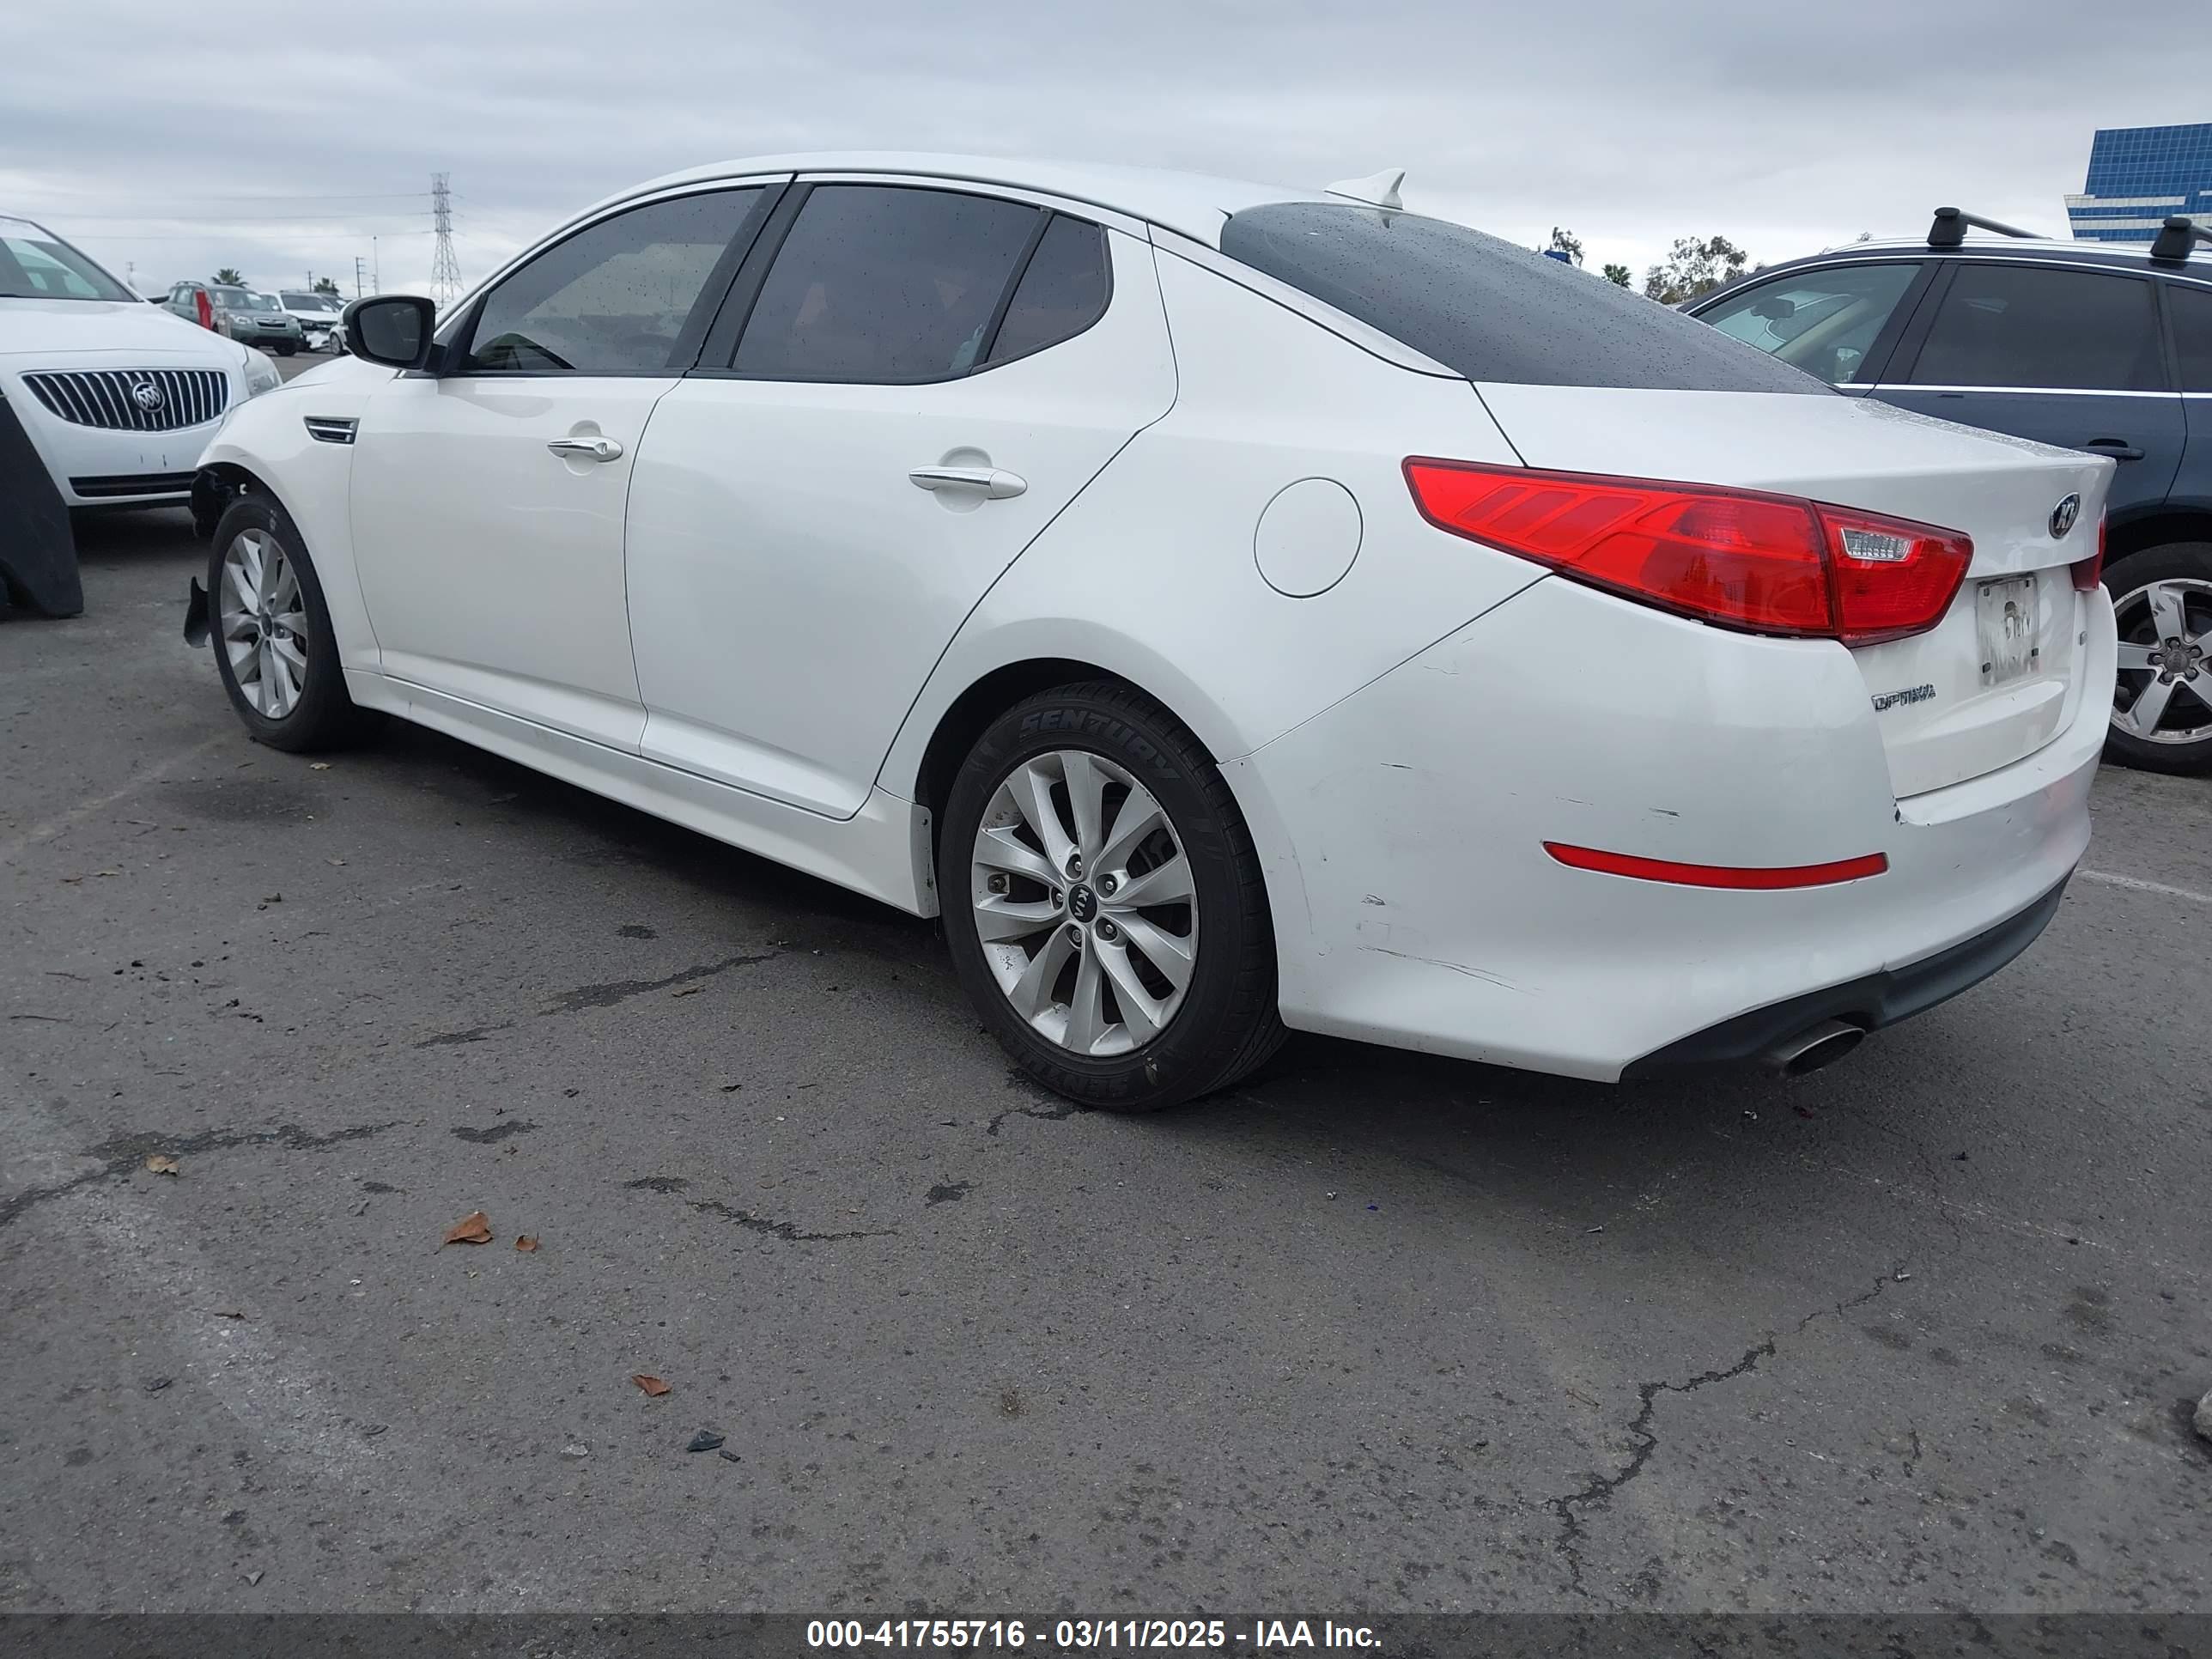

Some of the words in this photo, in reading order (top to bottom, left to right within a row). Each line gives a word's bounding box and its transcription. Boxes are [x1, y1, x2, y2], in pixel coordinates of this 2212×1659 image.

[1870, 684, 1937, 713] OPTIMA
[1018, 709, 1182, 780] SENTURY
[1073, 888, 1090, 917] KIA
